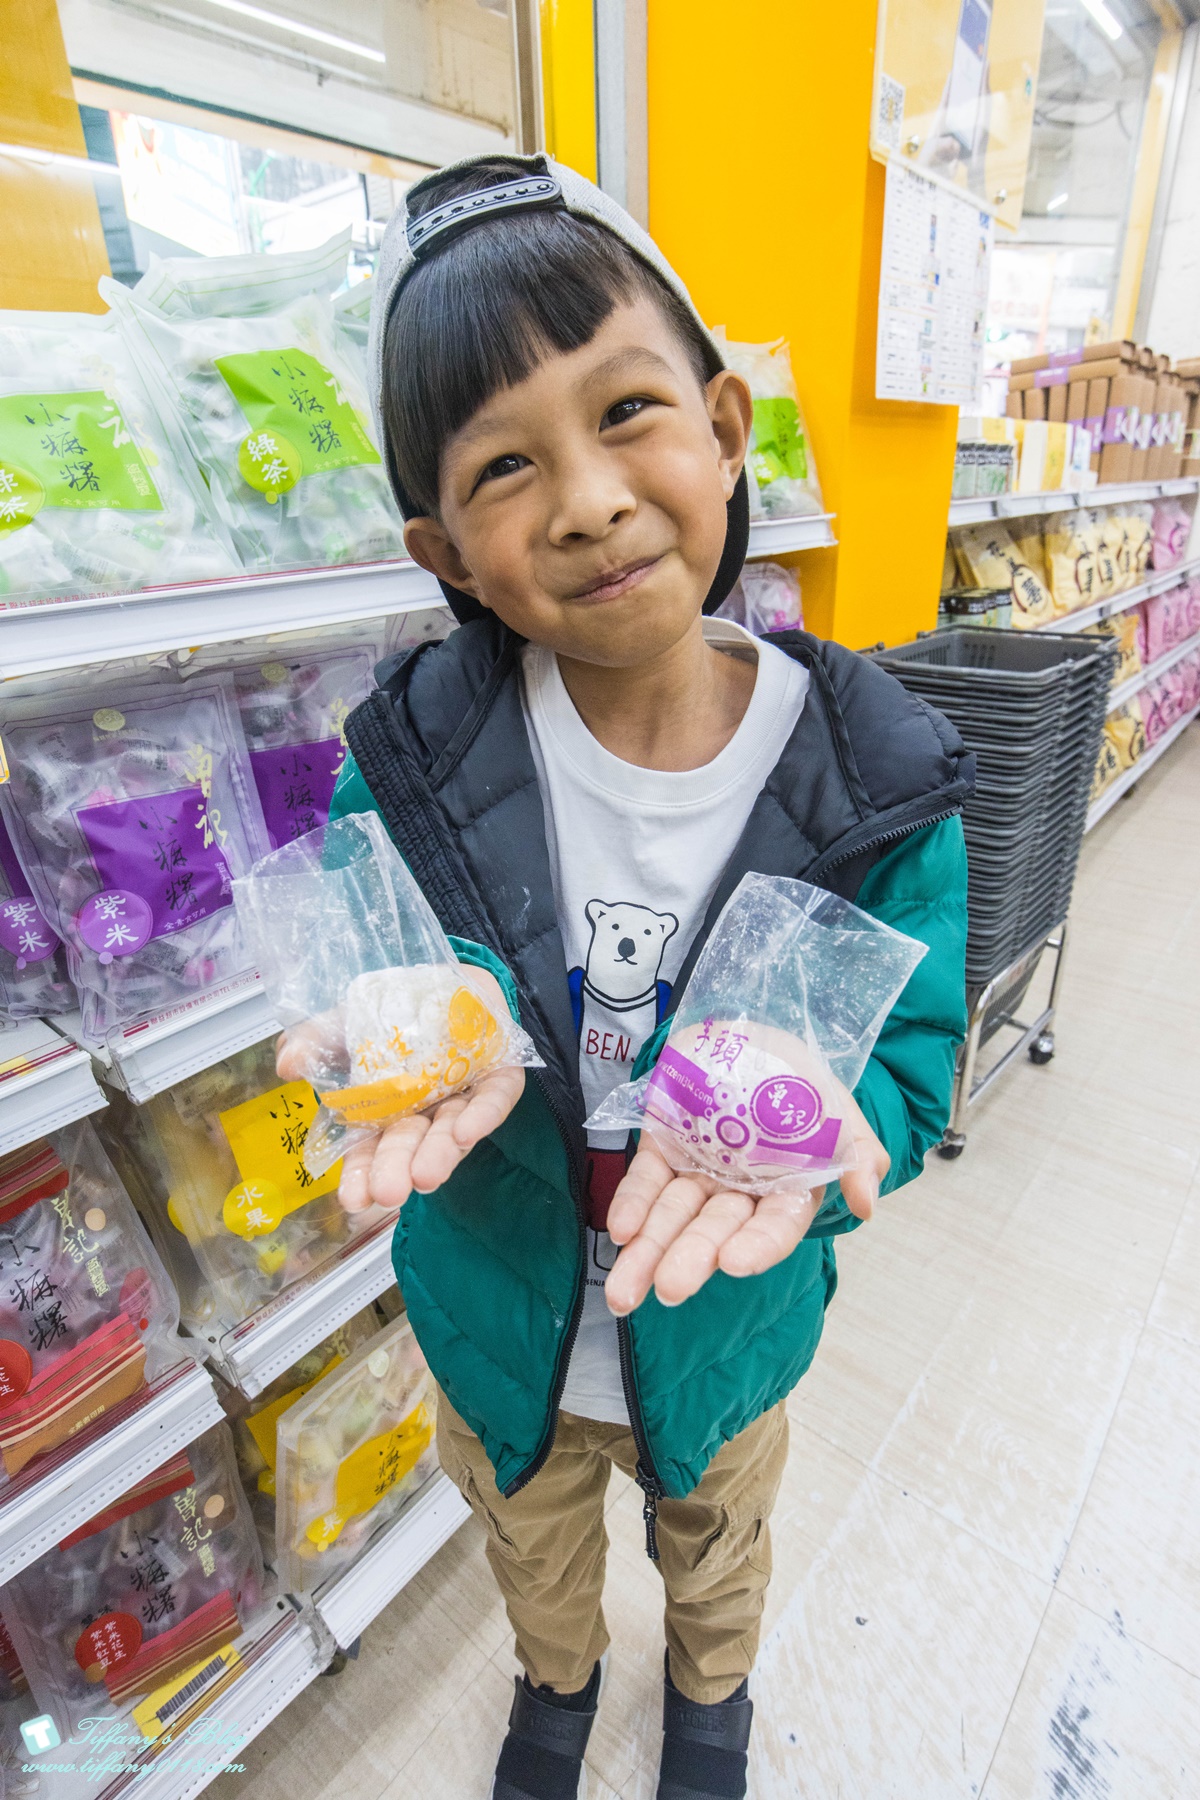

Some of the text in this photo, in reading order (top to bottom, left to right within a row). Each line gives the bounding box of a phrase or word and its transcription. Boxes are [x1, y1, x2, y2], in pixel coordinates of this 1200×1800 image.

[247, 434, 289, 484] 綠茶
[3, 902, 49, 953] 紫米
[95, 895, 139, 948] 紫米
[694, 1016, 750, 1071] 芋頭
[236, 1186, 273, 1231] 水果
[173, 1487, 213, 1551] 曾記
[90, 1629, 112, 1671] 紫米紅豆
[104, 1620, 127, 1661] 紫米花生
